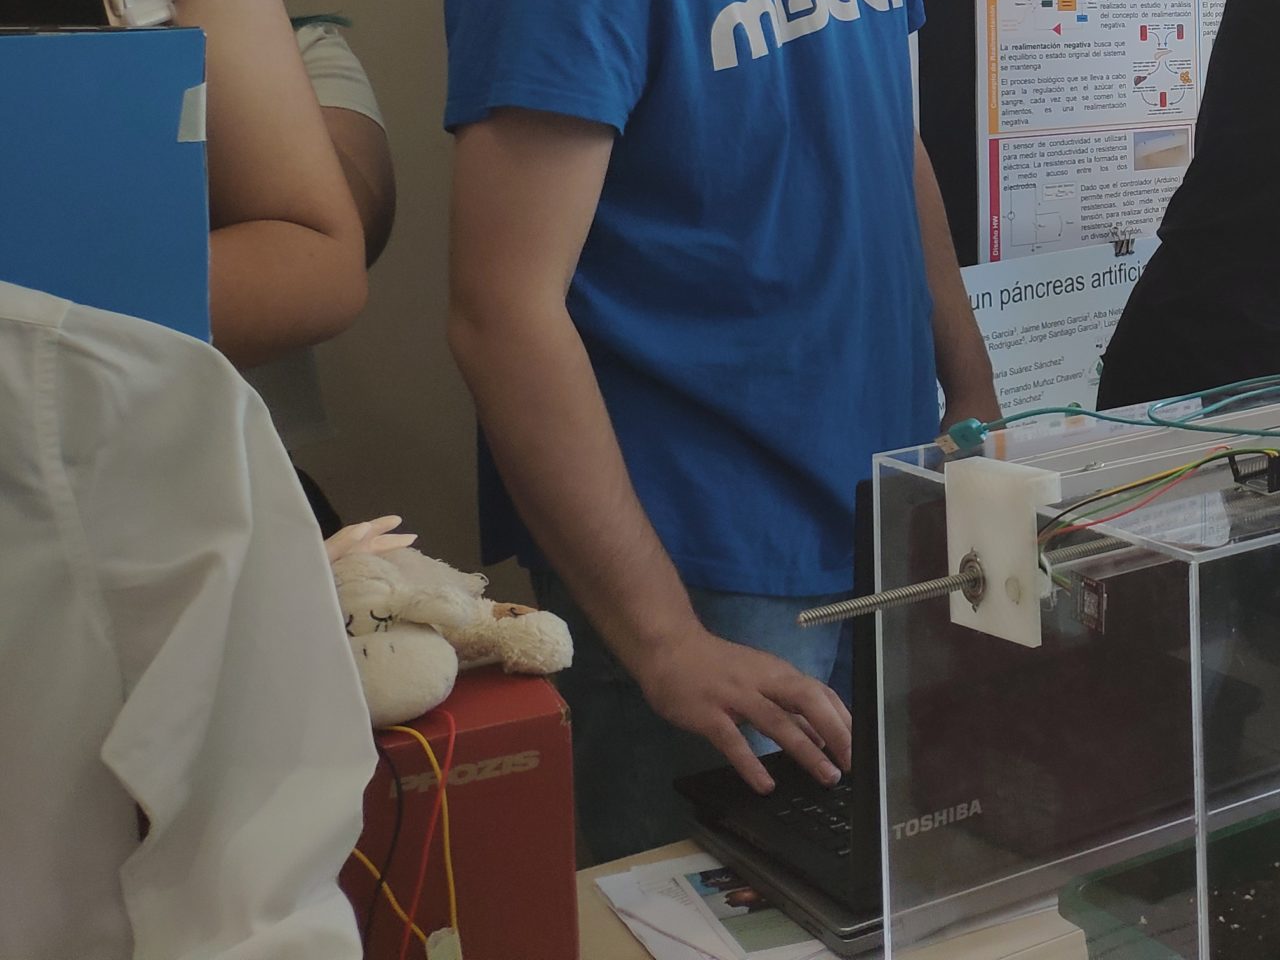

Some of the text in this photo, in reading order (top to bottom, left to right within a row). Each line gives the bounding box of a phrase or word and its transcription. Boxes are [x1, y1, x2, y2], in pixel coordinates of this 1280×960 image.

[1012, 42, 1061, 50] realimentación
[1064, 42, 1091, 50] negativa
[1002, 143, 1009, 151] El
[1049, 137, 1090, 147] conductividad
[991, 215, 998, 229] HW
[969, 260, 1148, 311] un páncreas artifici
[389, 750, 541, 798] PROZIS
[892, 798, 983, 840] TOSHIBA
